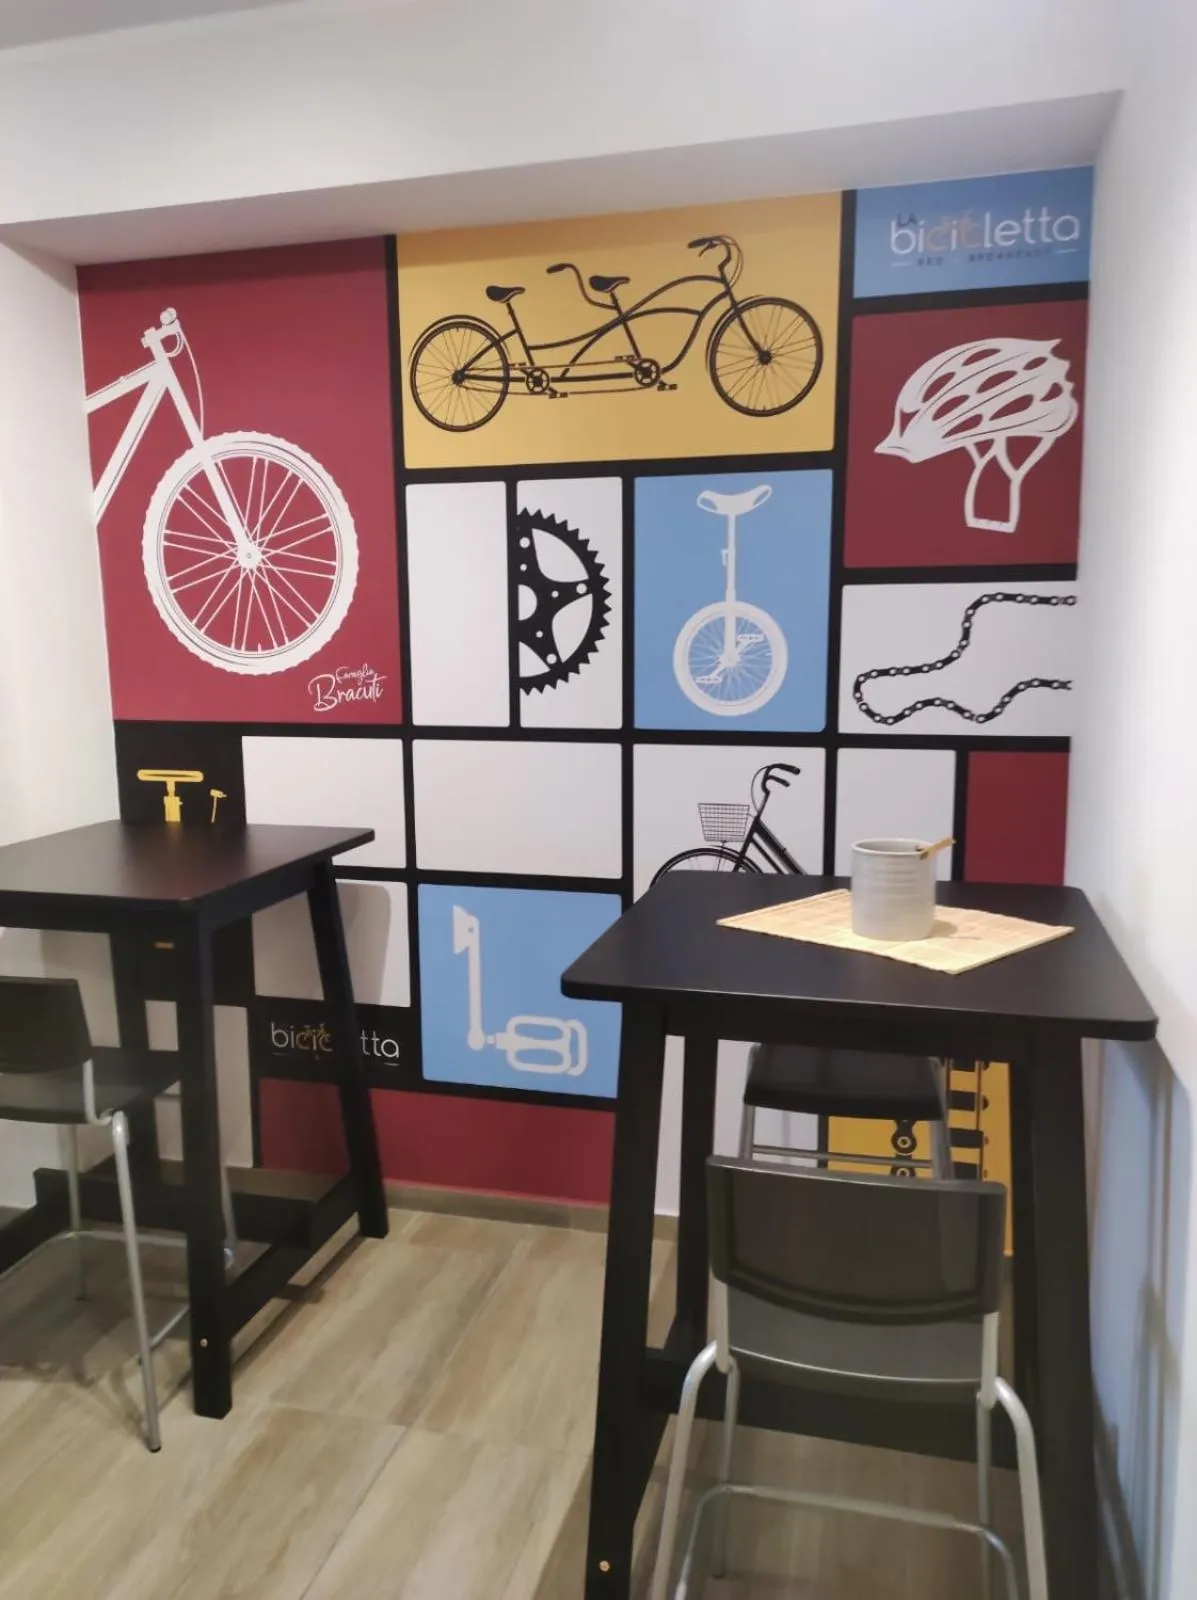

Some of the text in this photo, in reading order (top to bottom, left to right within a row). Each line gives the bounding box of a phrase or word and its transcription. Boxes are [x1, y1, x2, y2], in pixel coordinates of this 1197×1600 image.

[890, 206, 1080, 255] bicicletta
[896, 212, 918, 228] LA
[307, 673, 387, 712] Bracuti
[270, 1021, 400, 1058] bicictta
